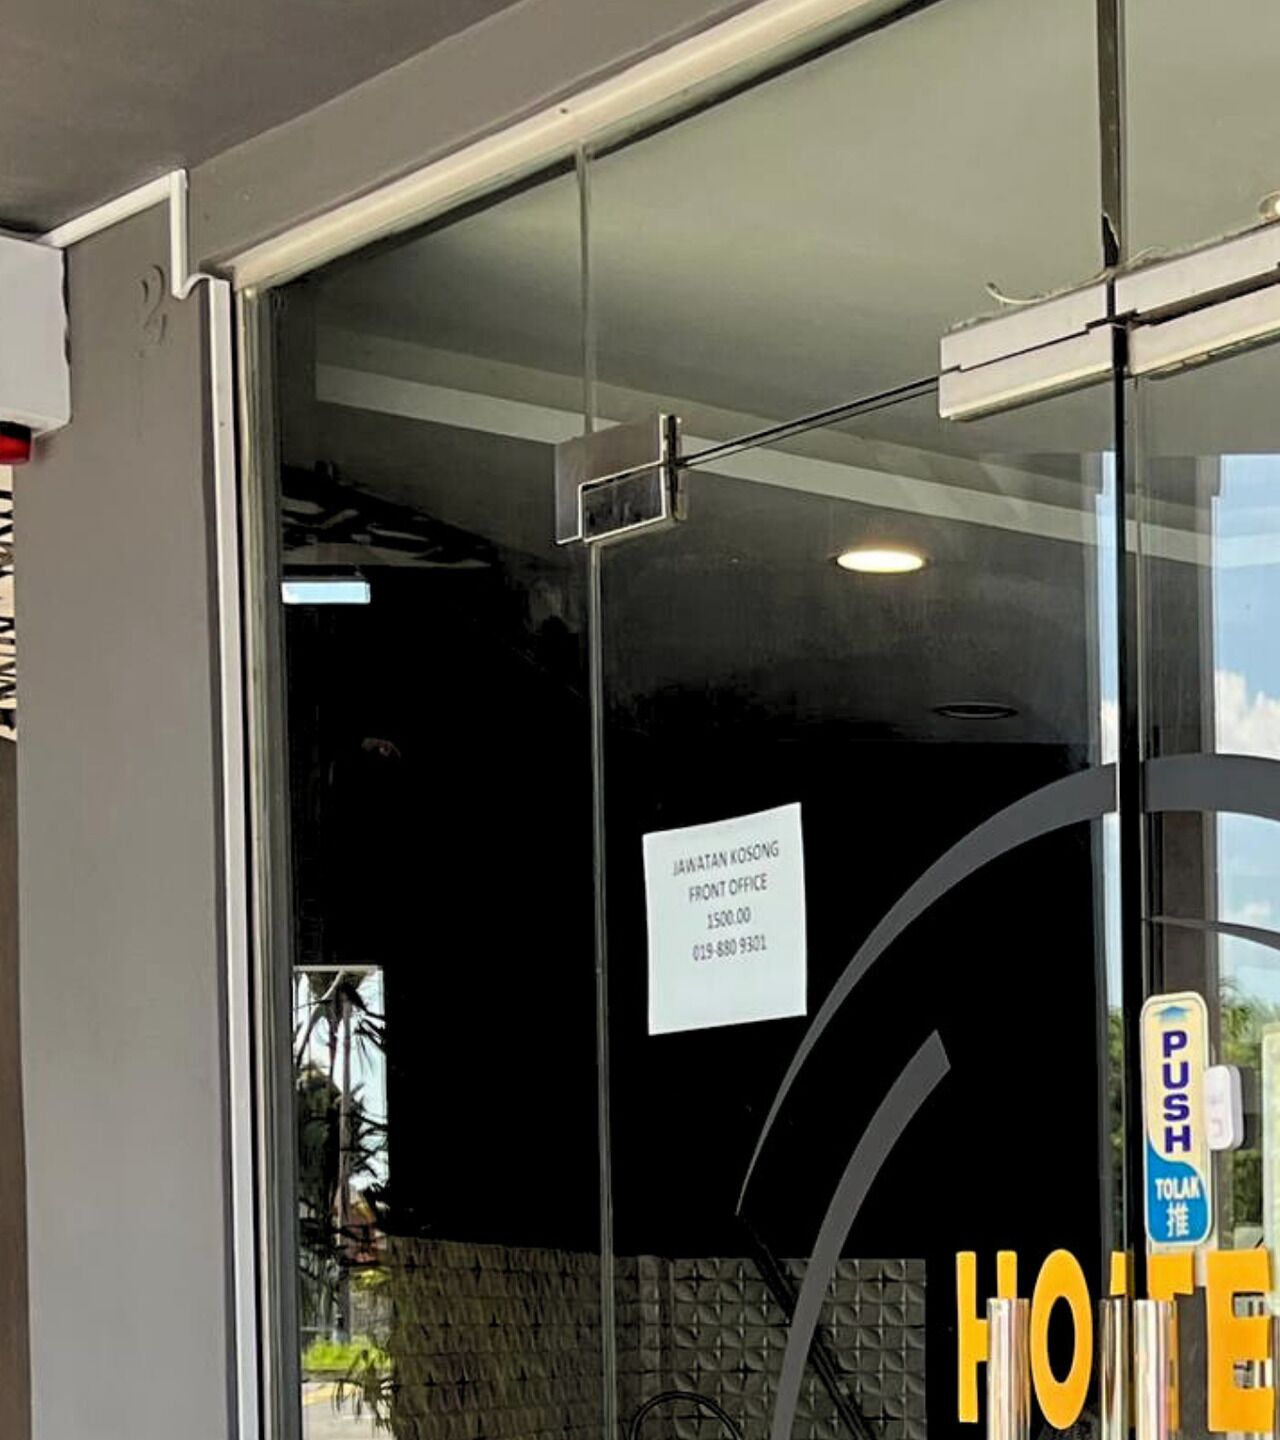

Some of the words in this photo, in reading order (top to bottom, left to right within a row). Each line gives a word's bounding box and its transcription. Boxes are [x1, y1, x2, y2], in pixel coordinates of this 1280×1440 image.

[673, 850, 728, 877] JAWATAN
[730, 839, 779, 865] KOSONG
[688, 880, 726, 902] FRONT
[729, 872, 768, 895] OFFICE
[707, 906, 751, 930] 1500.00
[739, 933, 767, 955] 9301
[1161, 1029, 1192, 1154] PUSH
[1154, 1176, 1201, 1200] TOLAK
[1166, 1202, 1190, 1237] 推
